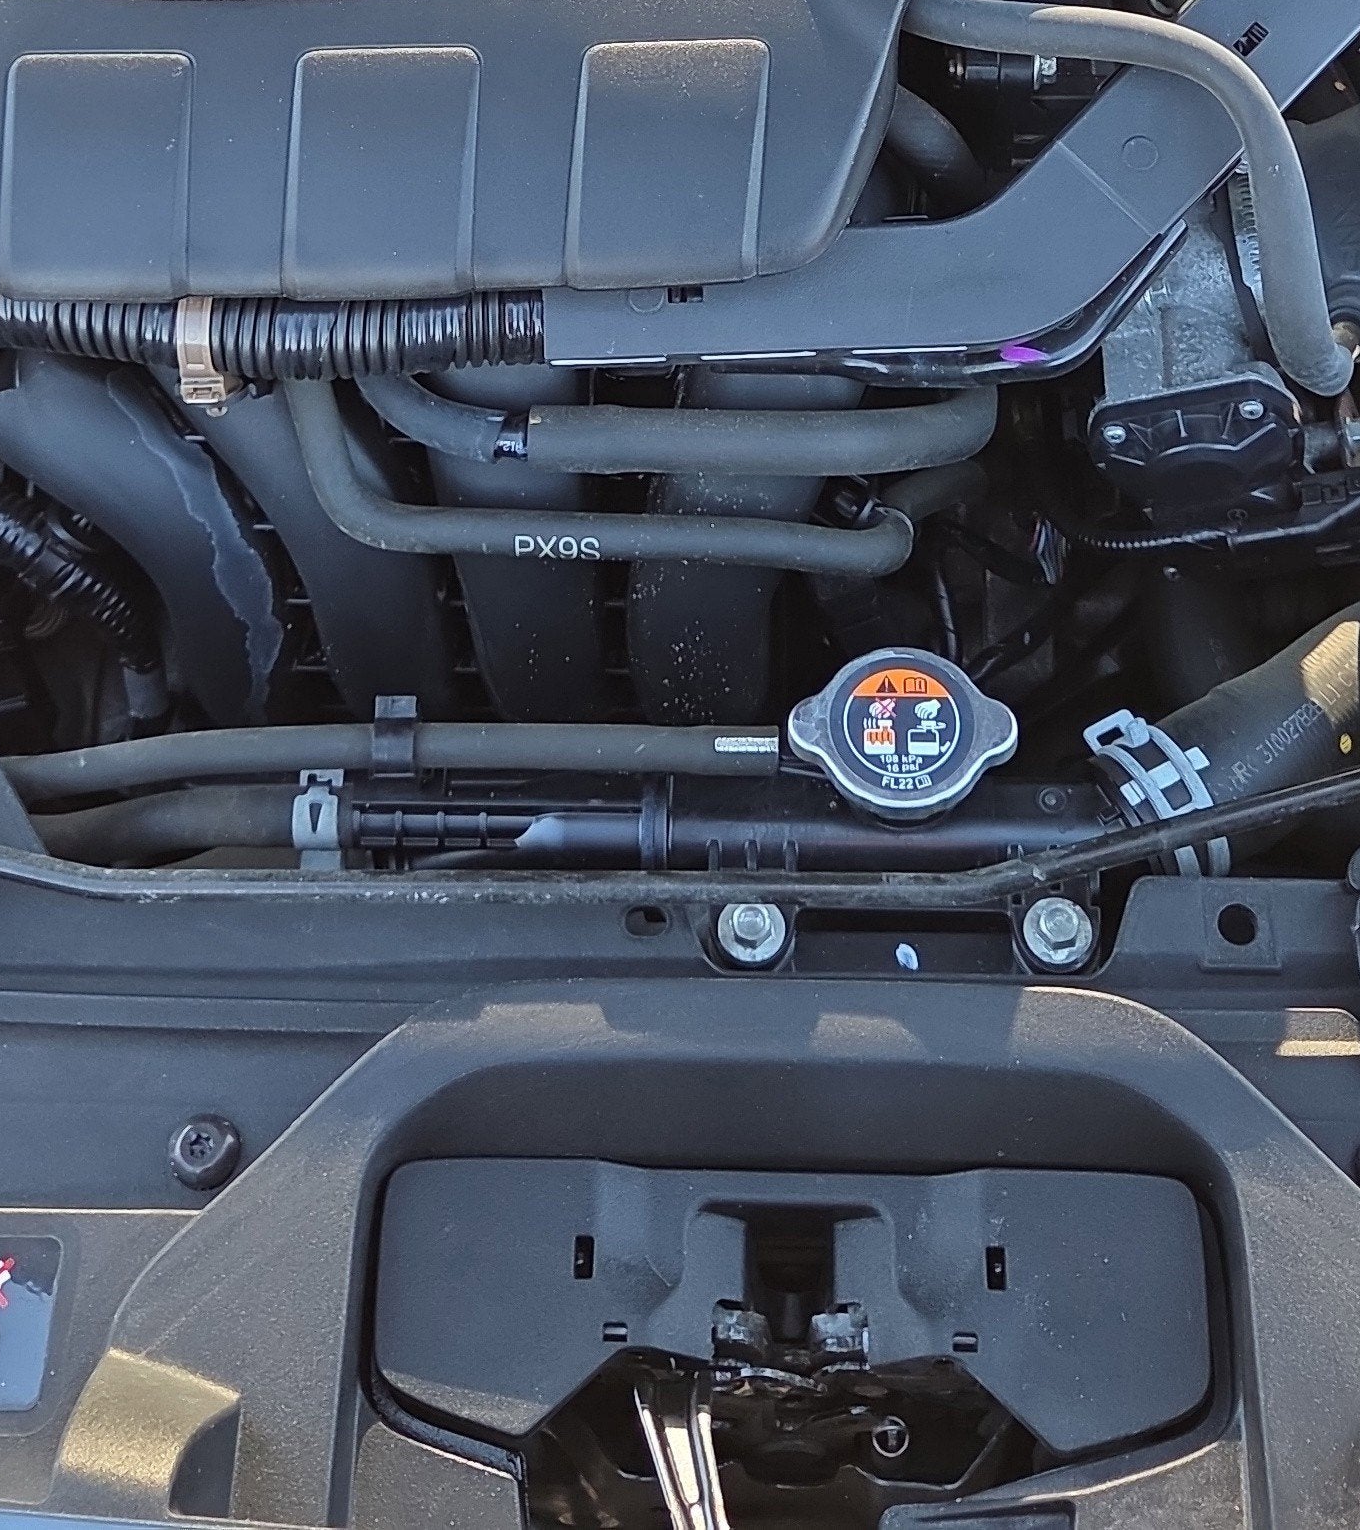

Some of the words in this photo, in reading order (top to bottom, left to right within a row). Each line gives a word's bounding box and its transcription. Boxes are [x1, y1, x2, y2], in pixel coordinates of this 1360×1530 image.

[514, 534, 602, 561] PX9S
[879, 754, 899, 764] 108
[901, 754, 923, 765] kPa
[886, 763, 900, 773] 16
[901, 763, 919, 773] psi
[881, 775, 914, 790] FL22
